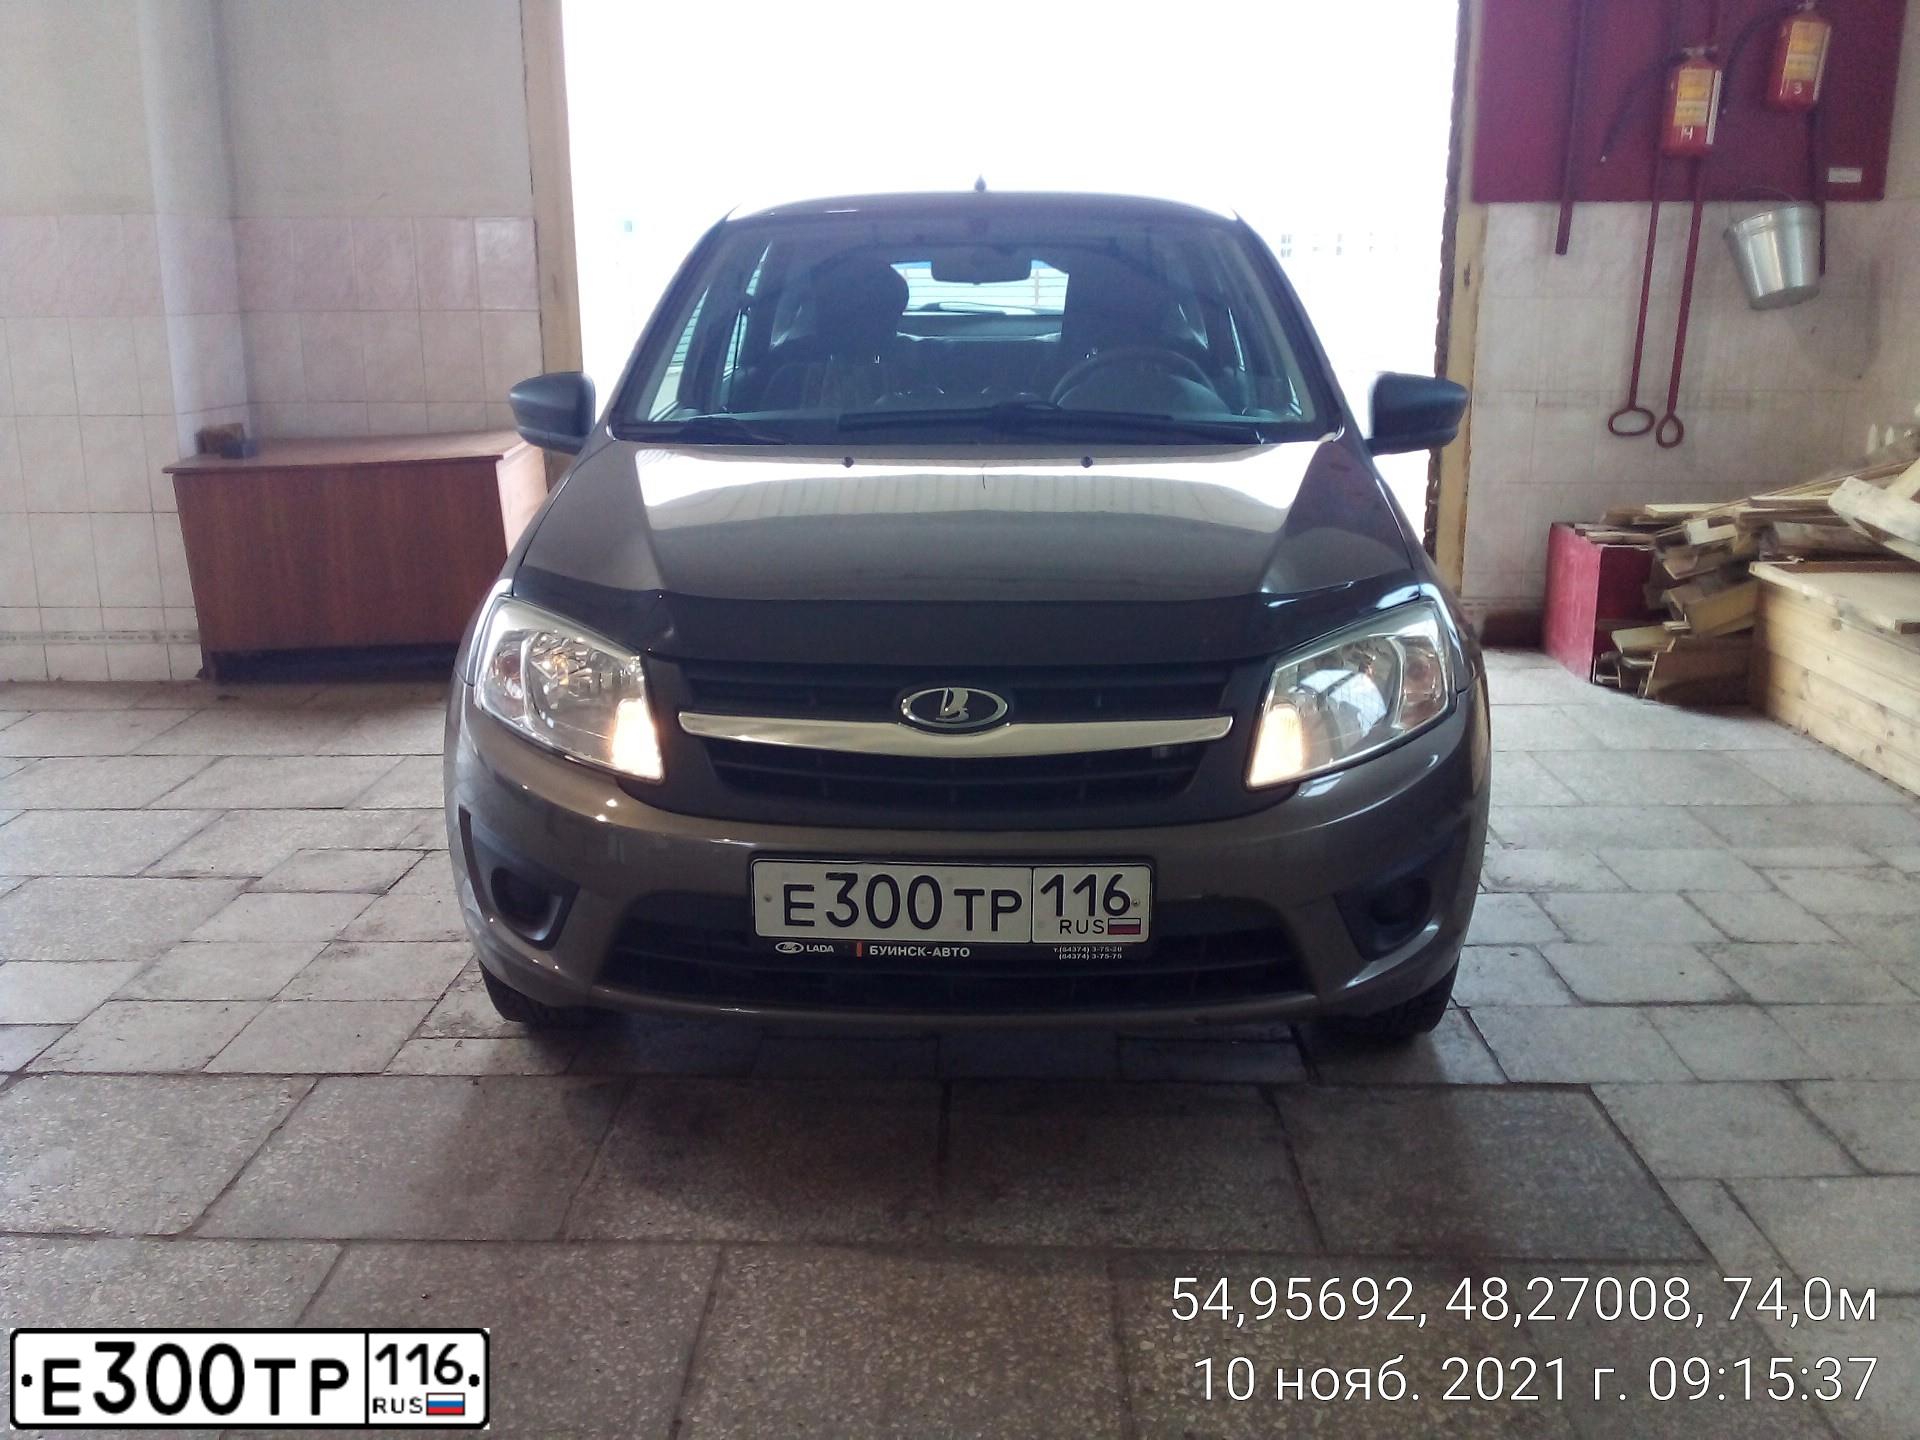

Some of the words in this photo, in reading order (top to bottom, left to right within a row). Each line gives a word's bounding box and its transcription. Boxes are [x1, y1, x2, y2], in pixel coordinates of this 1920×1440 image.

[1040, 873, 1131, 917] 116
[1059, 919, 1105, 935] RUS
[806, 944, 835, 953] LADA
[869, 945, 971, 958] БУИНСК-АВТО
